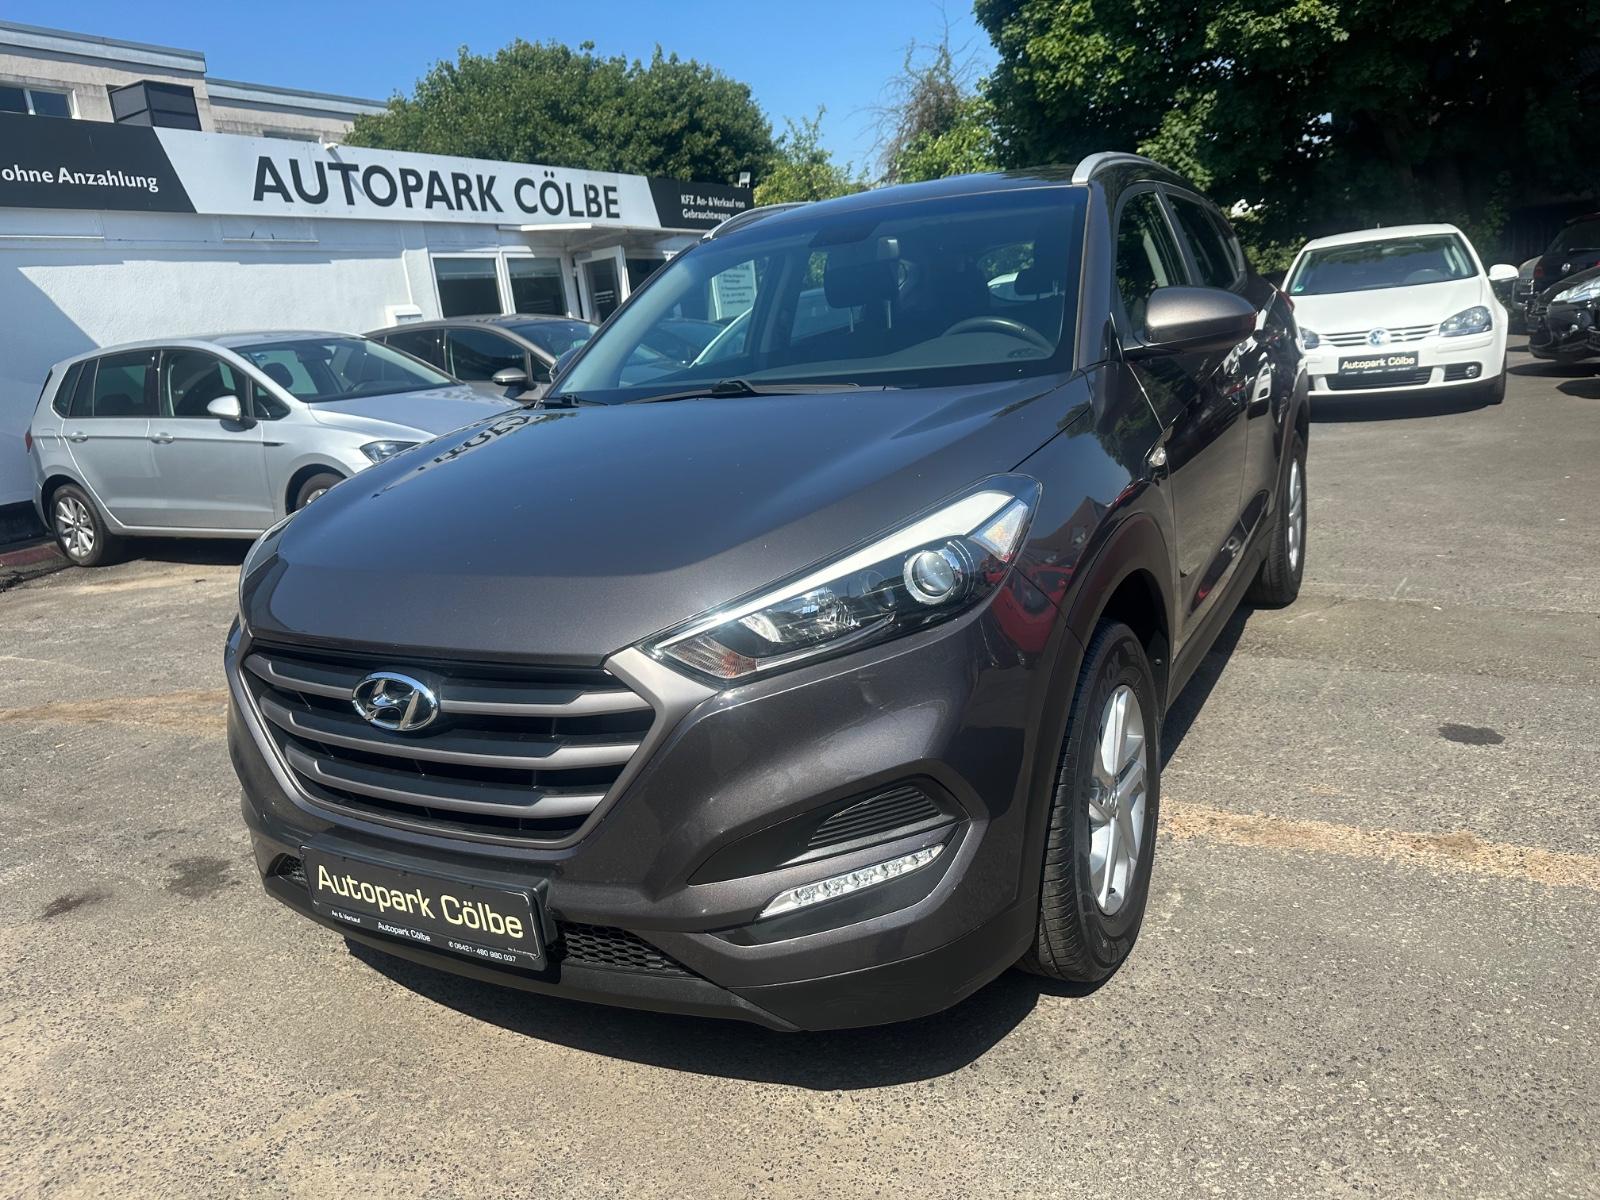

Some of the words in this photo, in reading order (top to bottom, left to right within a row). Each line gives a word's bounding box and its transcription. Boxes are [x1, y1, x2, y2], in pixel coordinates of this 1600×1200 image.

[1, 163, 54, 184] ohne
[58, 166, 159, 193] Anzahlung
[252, 155, 504, 213] AUTOPARK
[513, 170, 621, 219] CÖLBE
[680, 194, 695, 206] KFZ
[1342, 358, 1386, 370] Autopark
[317, 864, 436, 920] Autopark
[440, 894, 524, 939] Cölbe
[377, 921, 410, 936] Autopark
